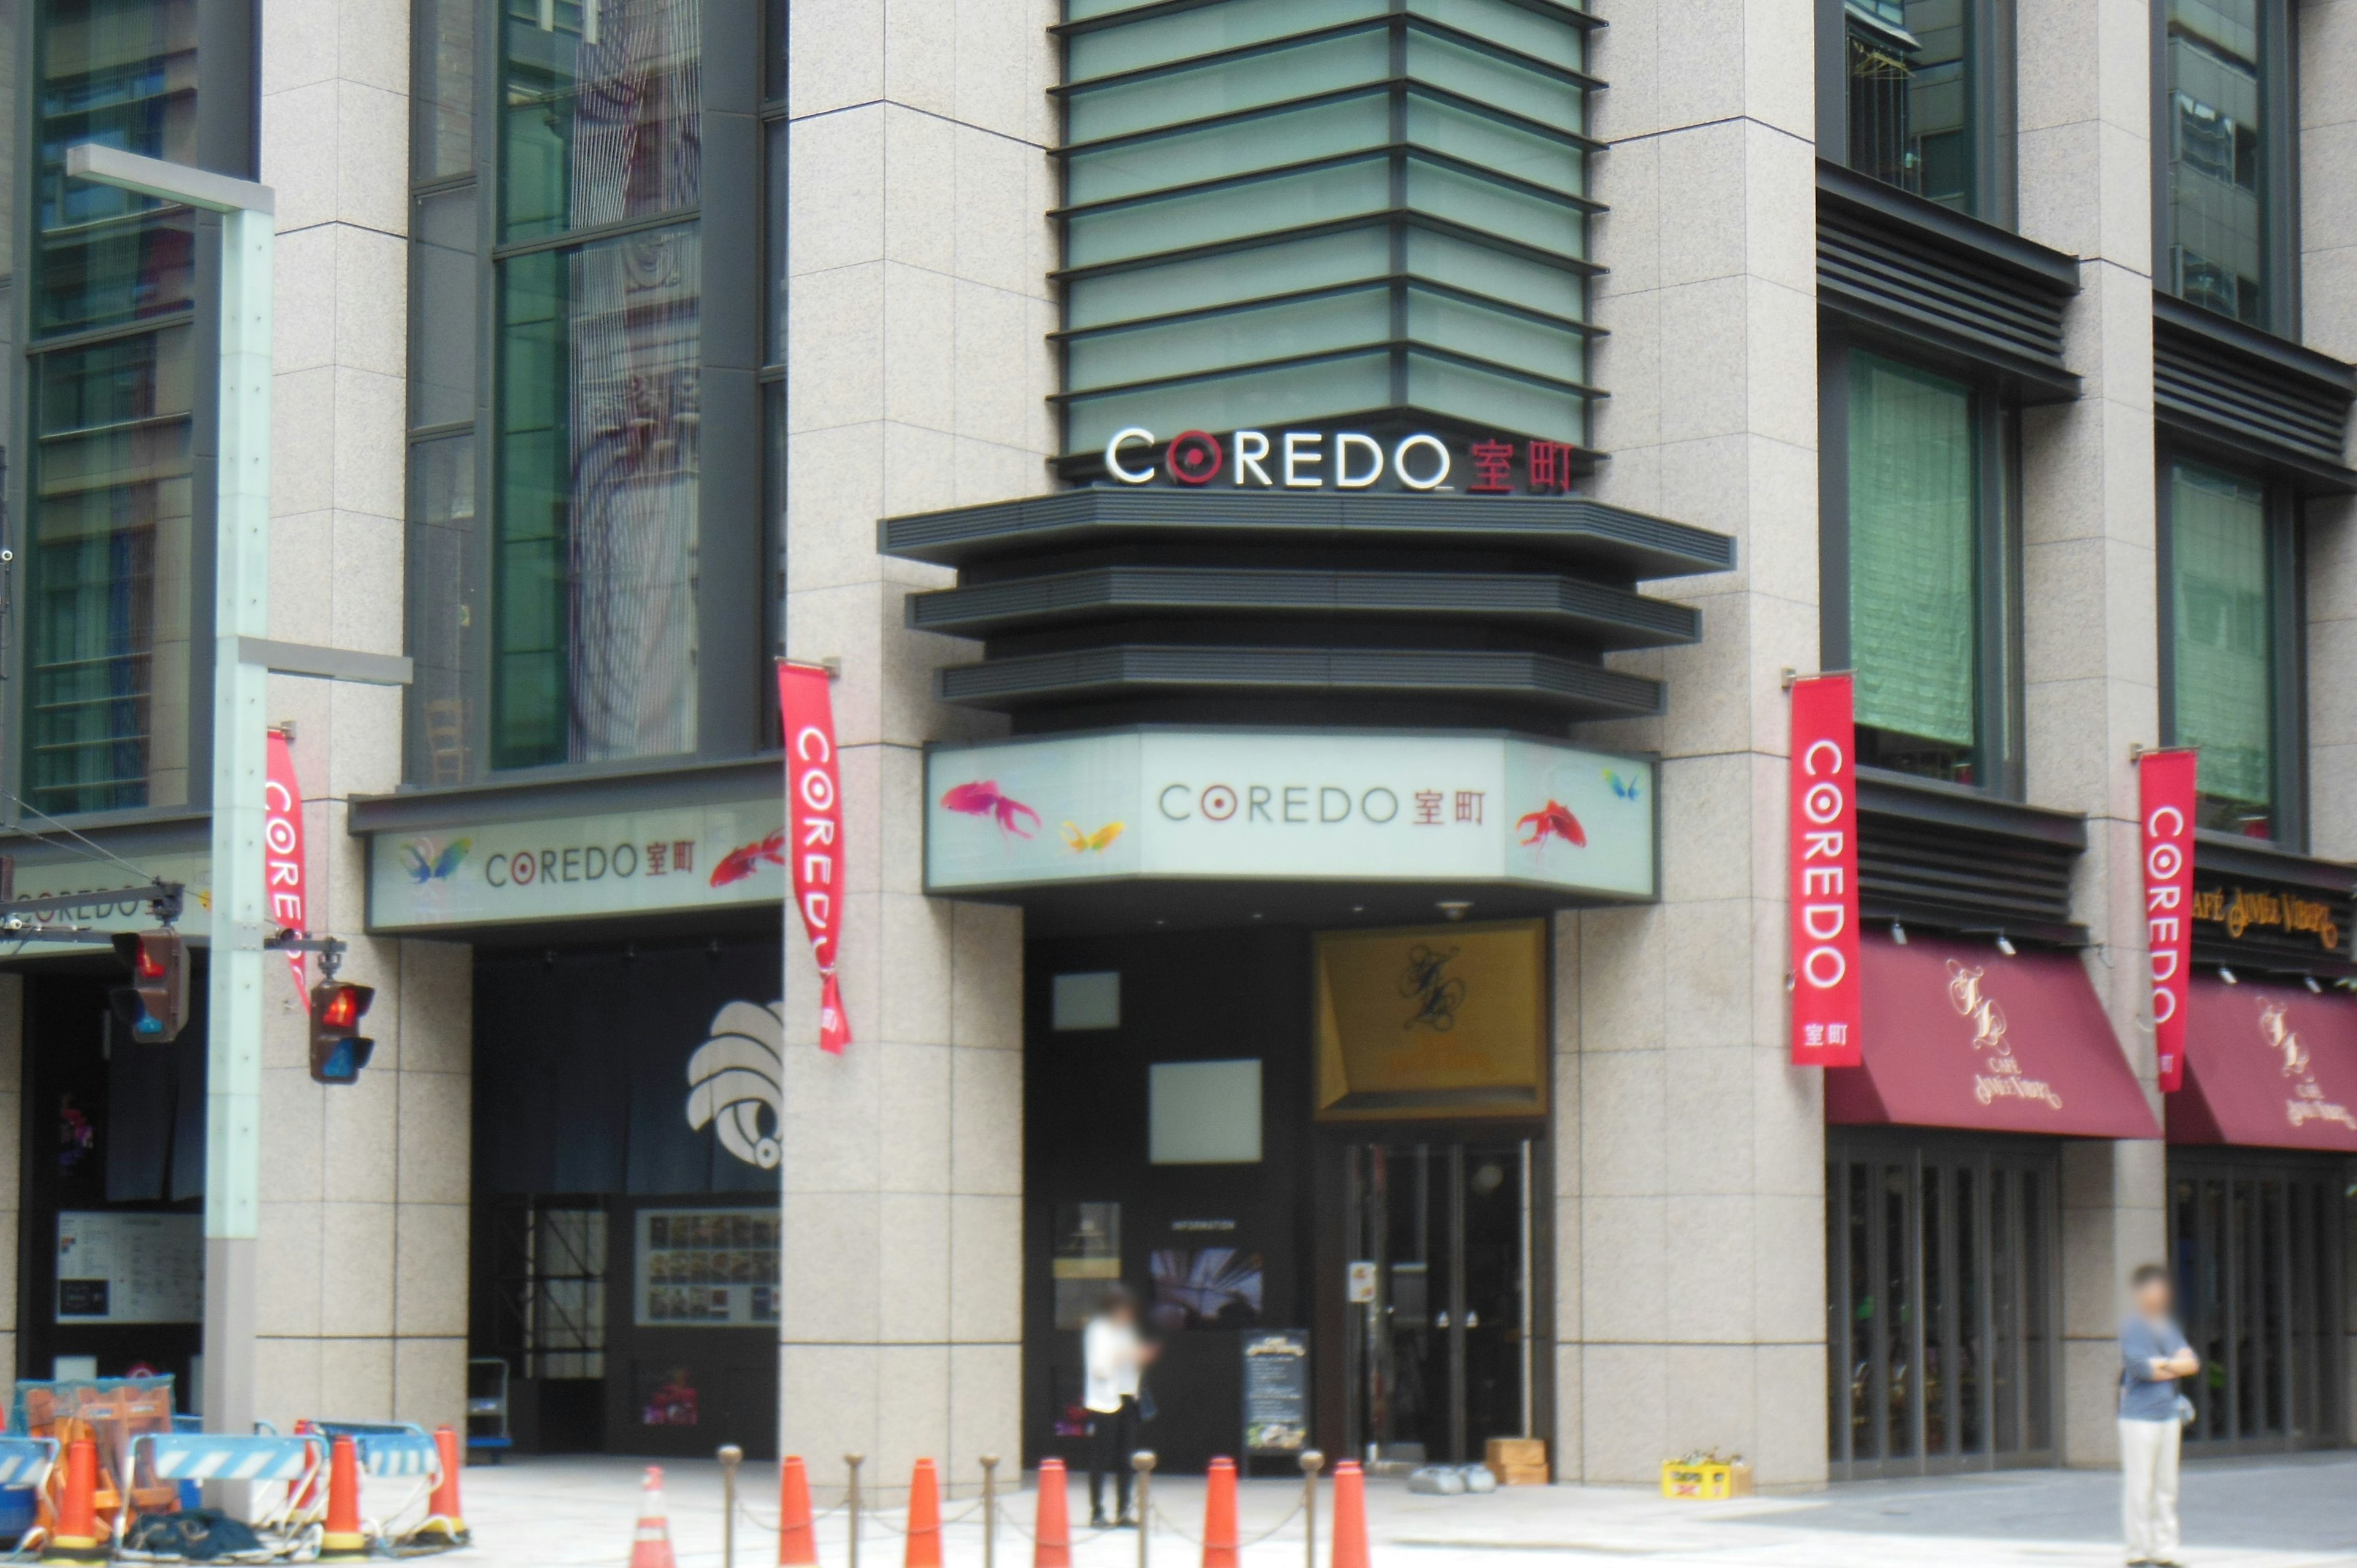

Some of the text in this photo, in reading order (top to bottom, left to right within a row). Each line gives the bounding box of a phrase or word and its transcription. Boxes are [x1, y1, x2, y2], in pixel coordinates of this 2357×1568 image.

[1107, 428, 1576, 492] COREDO 室町
[1159, 784, 1485, 825] COREDO 室町
[486, 841, 695, 887] COREDO 室町
[1805, 740, 1845, 988] COREDO
[1805, 1024, 1848, 1046] 室町
